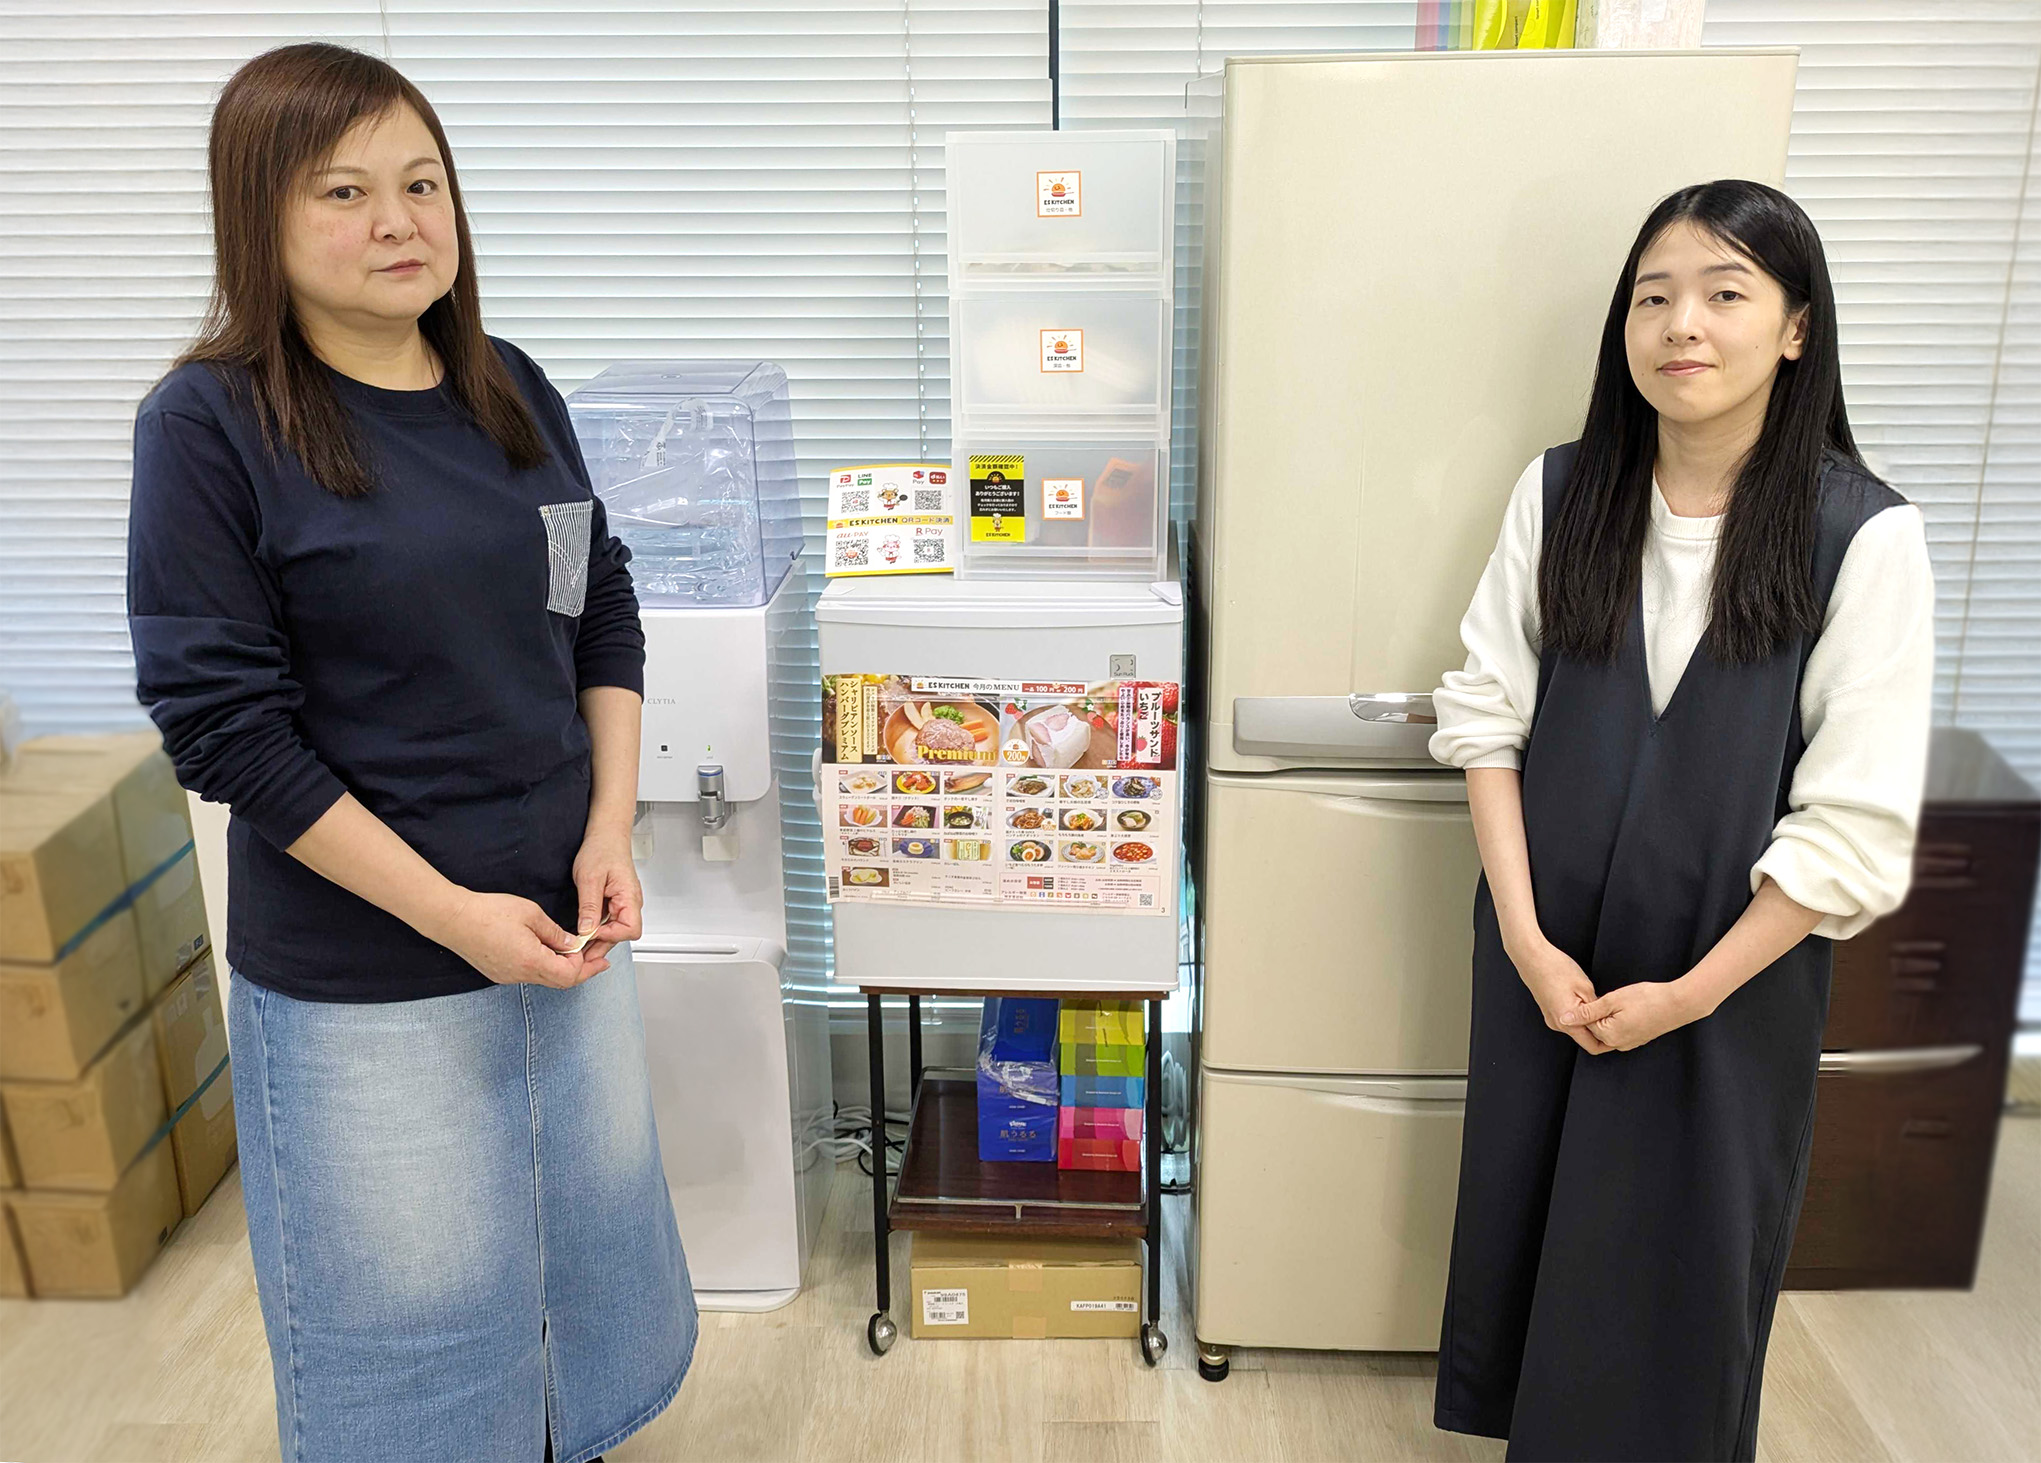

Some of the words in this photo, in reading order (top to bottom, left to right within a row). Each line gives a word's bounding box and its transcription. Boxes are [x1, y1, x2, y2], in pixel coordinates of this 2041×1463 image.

[849, 519, 860, 527] ES
[861, 517, 898, 526] KITCHEN
[916, 527, 923, 536] R
[925, 527, 943, 536] Pay
[928, 681, 938, 689] ES
[938, 682, 970, 690] KITCHEN
[1139, 693, 1150, 720] いちご
[840, 682, 850, 761] ハンバーグプレミアム
[917, 745, 996, 761] Premium
[1160, 906, 1166, 914] 3
